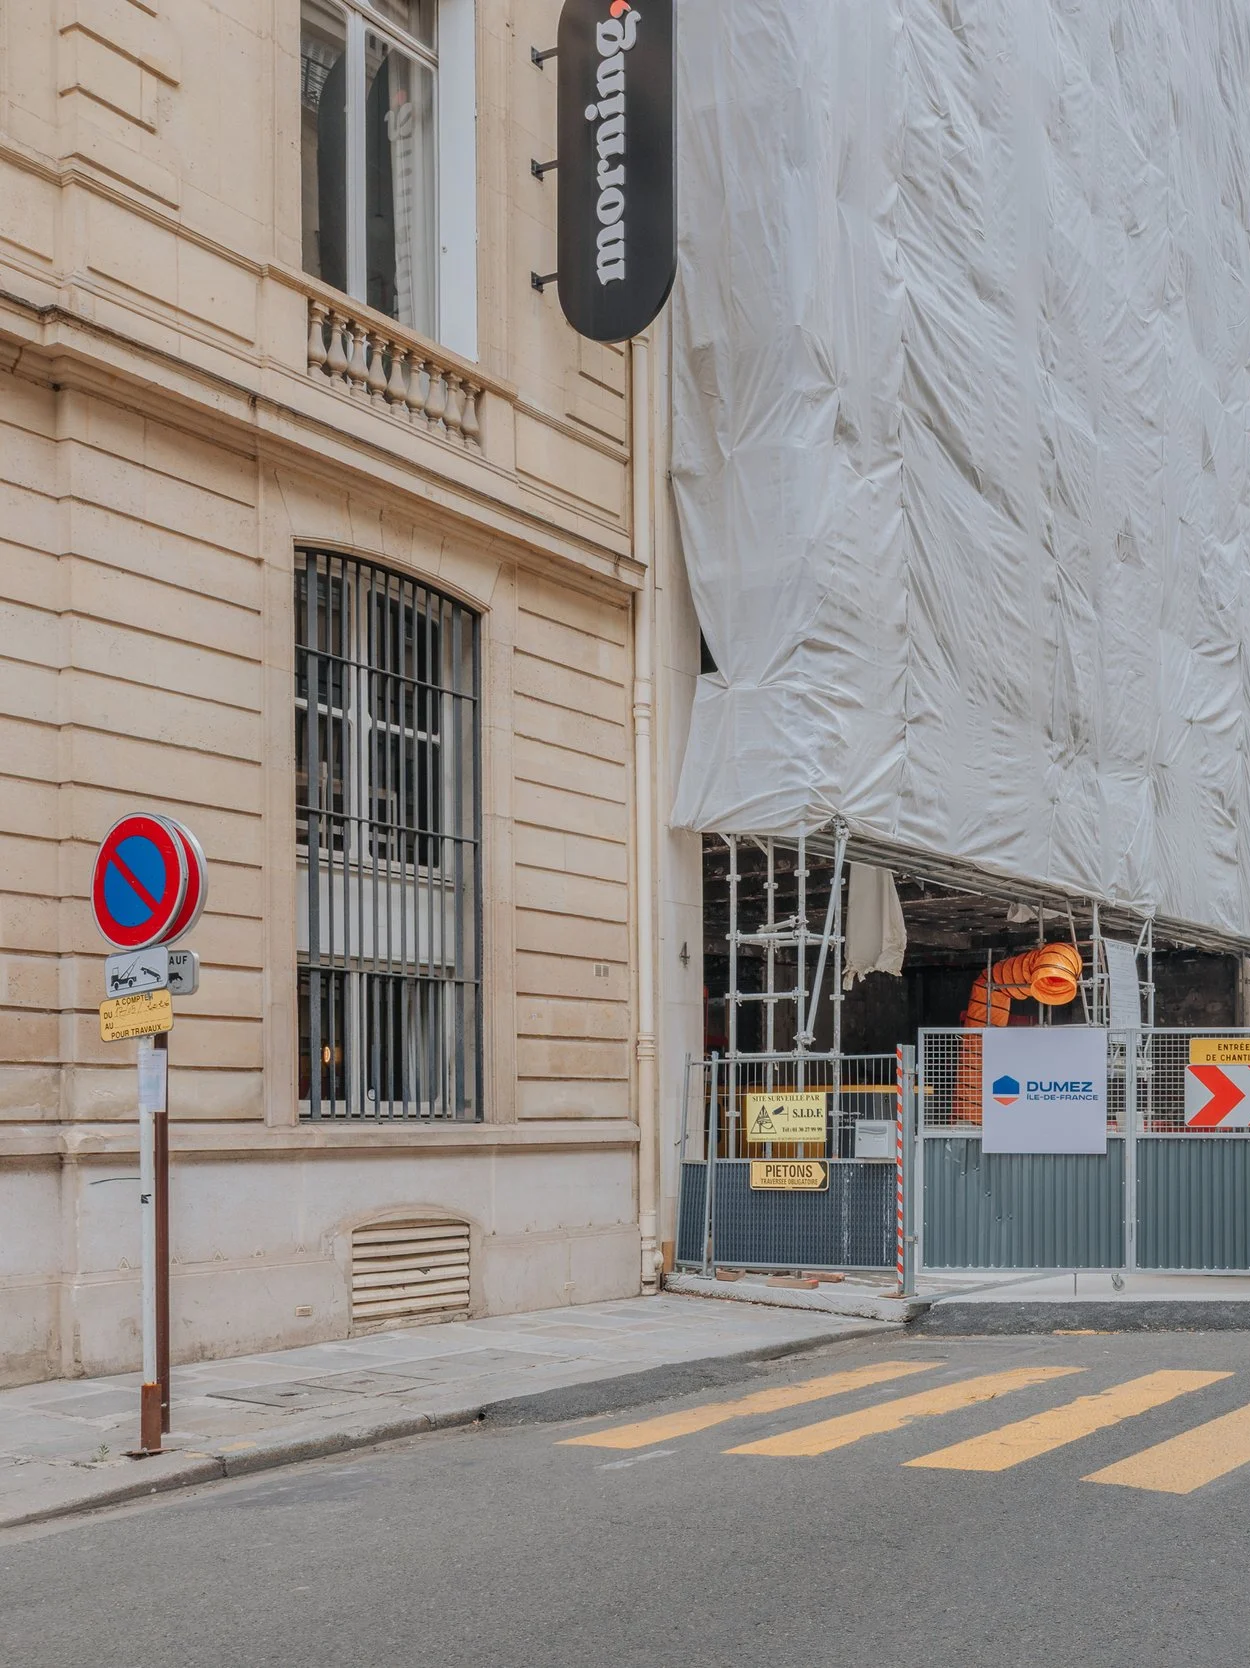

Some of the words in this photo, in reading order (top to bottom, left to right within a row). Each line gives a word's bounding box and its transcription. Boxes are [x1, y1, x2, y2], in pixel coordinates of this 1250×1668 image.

[585, 10, 641, 286] morning
[168, 955, 188, 965] AUF
[103, 1012, 113, 1020] DU
[111, 1029, 130, 1040] POUR
[131, 1024, 162, 1036] TRAVAUX
[1217, 1042, 1250, 1051] ENTRÉE
[1026, 1081, 1093, 1092] DUMEZ
[1026, 1092, 1099, 1101] ÎLE-DE-FRANCE
[765, 1165, 813, 1178] PIETONS
